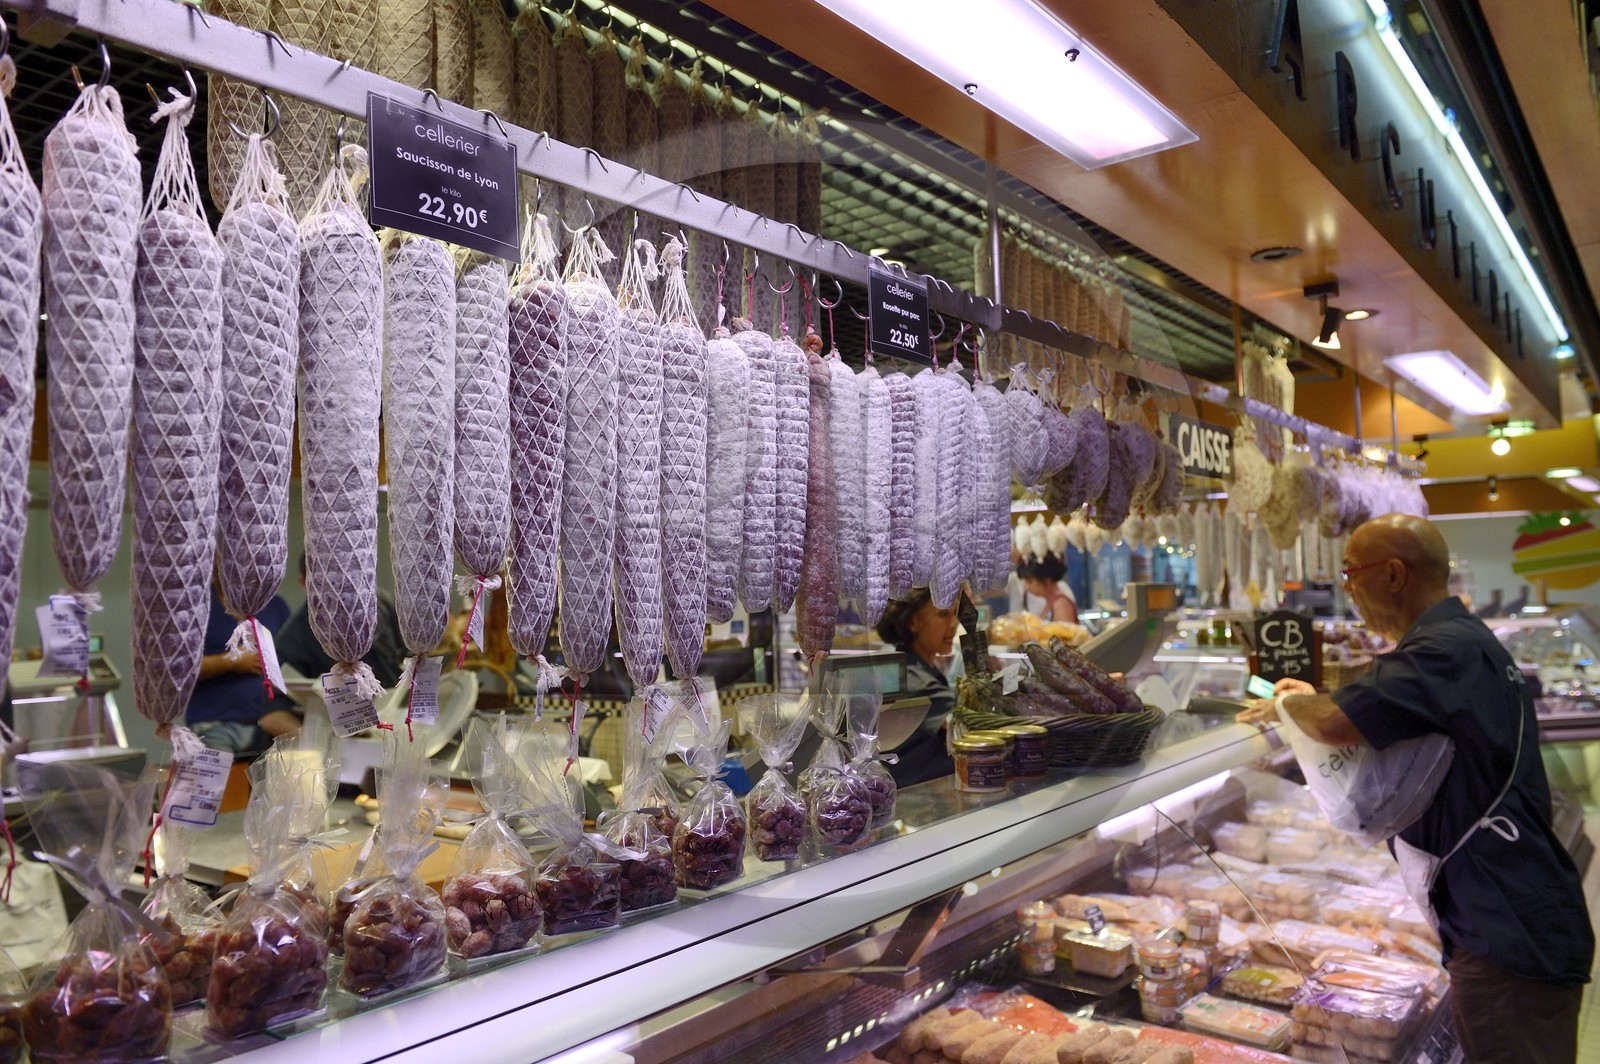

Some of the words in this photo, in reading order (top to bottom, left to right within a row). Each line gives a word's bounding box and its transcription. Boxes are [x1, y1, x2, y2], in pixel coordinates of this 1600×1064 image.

[415, 124, 480, 157] cellerier
[396, 147, 454, 175] Saucisson
[457, 167, 472, 181] de
[475, 173, 499, 190] Lyon
[441, 186, 449, 195] le
[449, 187, 462, 199] kilo
[418, 192, 488, 228] 22,90€
[887, 283, 914, 301] cellerier
[882, 301, 901, 314] Rosette
[901, 309, 910, 317] pur
[890, 328, 919, 349] 22,50€
[1178, 422, 1231, 474] CAISSE
[1260, 619, 1304, 649] CB
